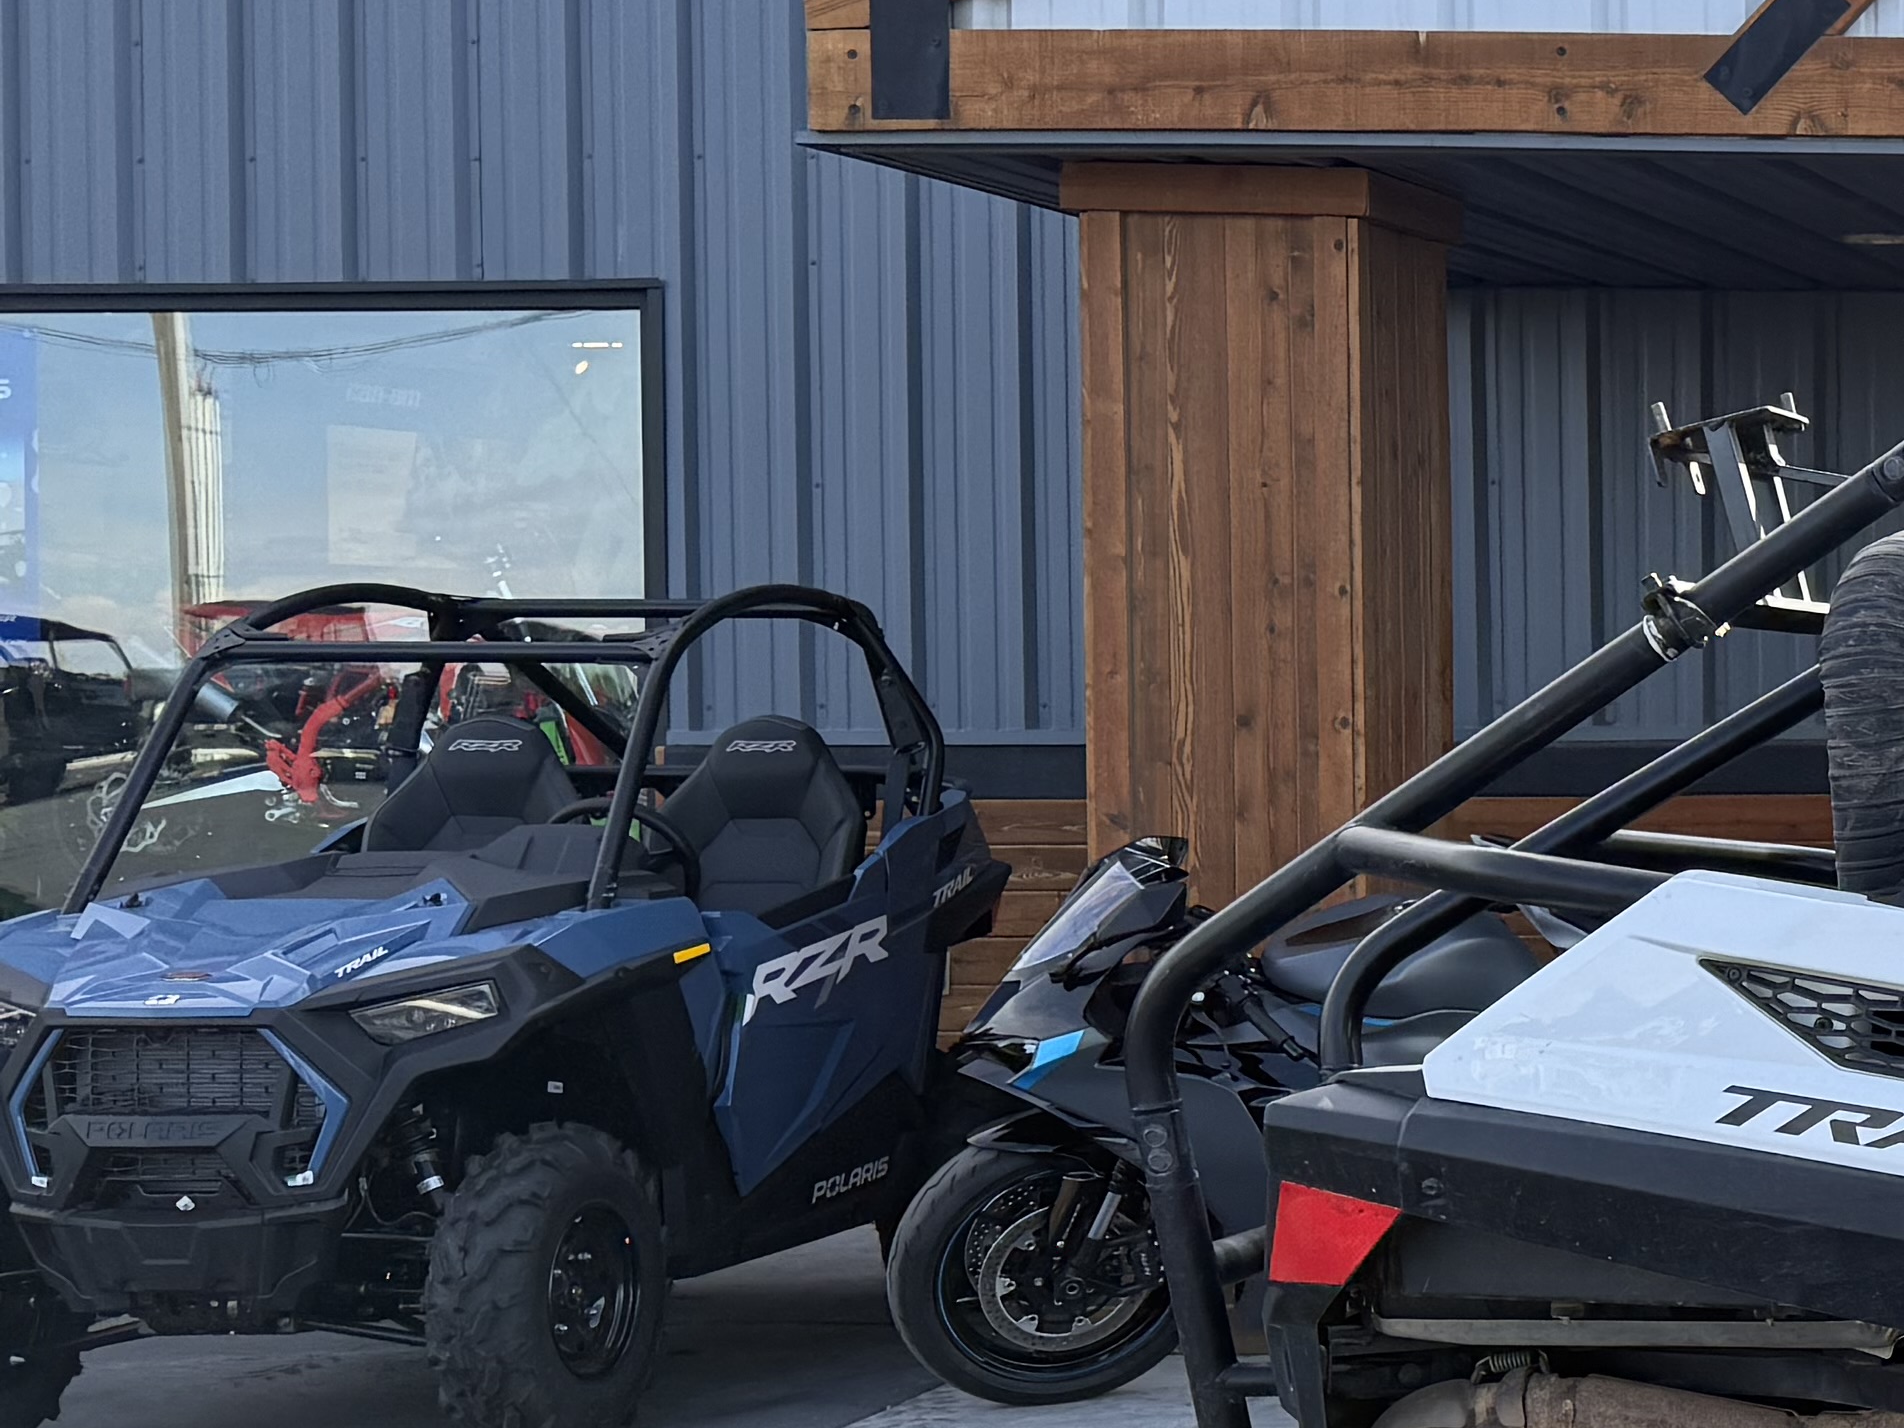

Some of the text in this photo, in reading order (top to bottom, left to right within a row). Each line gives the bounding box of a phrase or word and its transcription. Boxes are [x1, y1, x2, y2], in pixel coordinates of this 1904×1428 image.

[933, 865, 976, 908] TRAIL
[334, 946, 389, 978] TRAIL
[744, 915, 889, 1027] RZR
[811, 1155, 890, 1204] POLARIS
